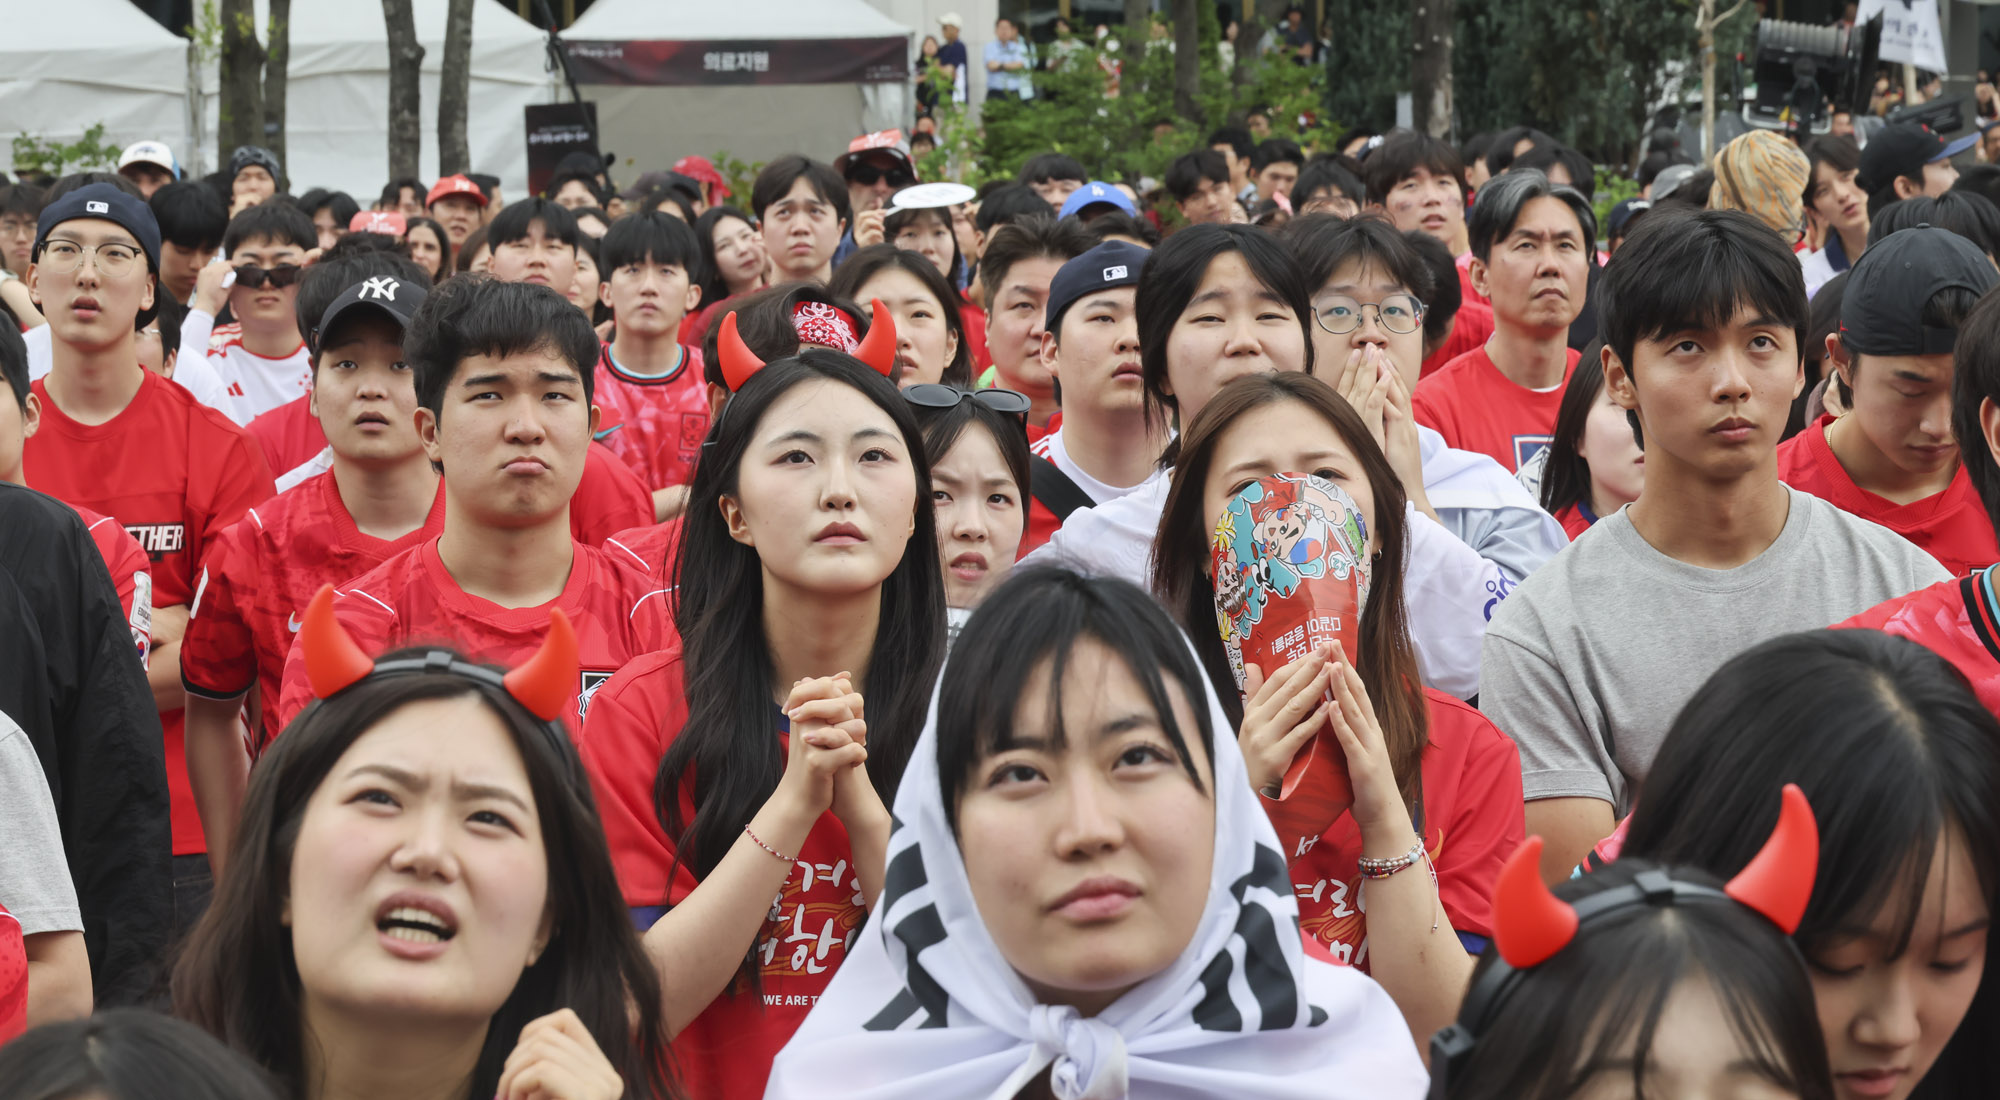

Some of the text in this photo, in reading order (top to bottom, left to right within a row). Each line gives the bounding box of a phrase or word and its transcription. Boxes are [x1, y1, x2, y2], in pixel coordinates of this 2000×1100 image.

[704, 51, 769, 72] 의료지원
[358, 276, 400, 301] NY
[1271, 616, 1341, 655] 다같이 응원을!
[1295, 835, 1319, 857] kt
[763, 995, 782, 1005] WE
[785, 995, 808, 1005] ARE
